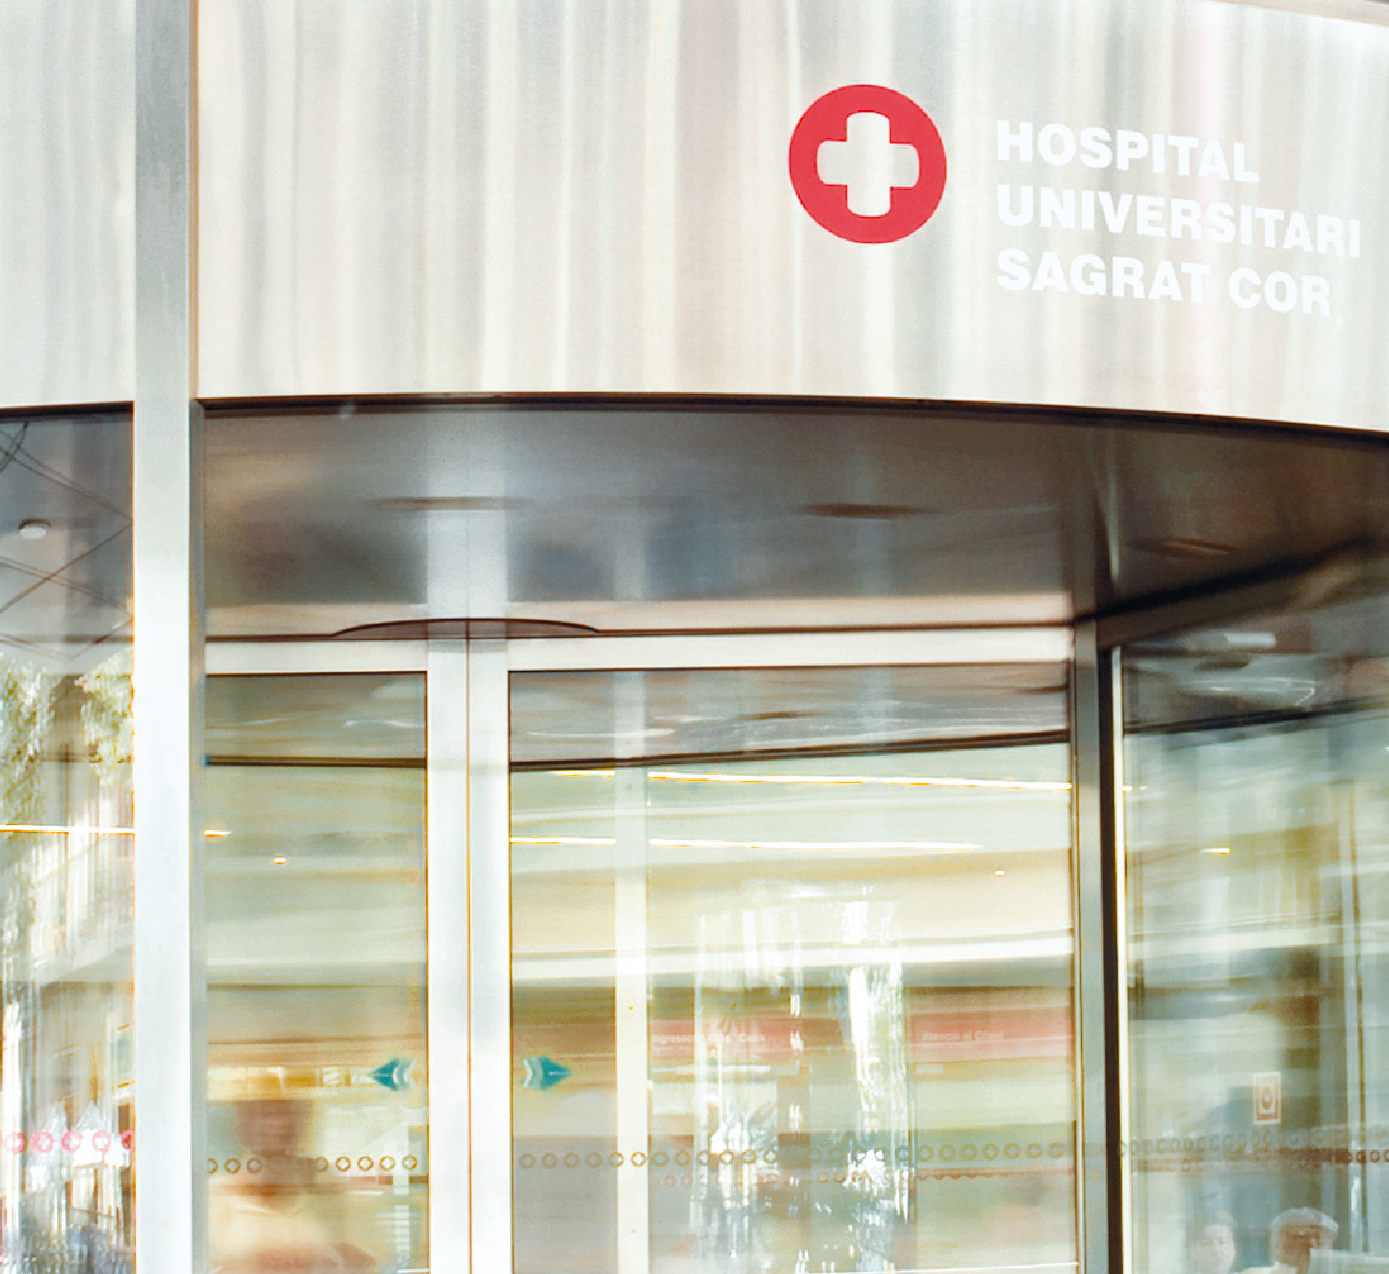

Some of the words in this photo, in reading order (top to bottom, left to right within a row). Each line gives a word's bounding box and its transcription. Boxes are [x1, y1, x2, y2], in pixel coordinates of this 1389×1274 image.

[996, 119, 1260, 184] HOSPITAL
[997, 184, 1362, 258] UNIVERSITARI
[997, 248, 1211, 305] SAGRAT
[1227, 270, 1331, 317] COR
